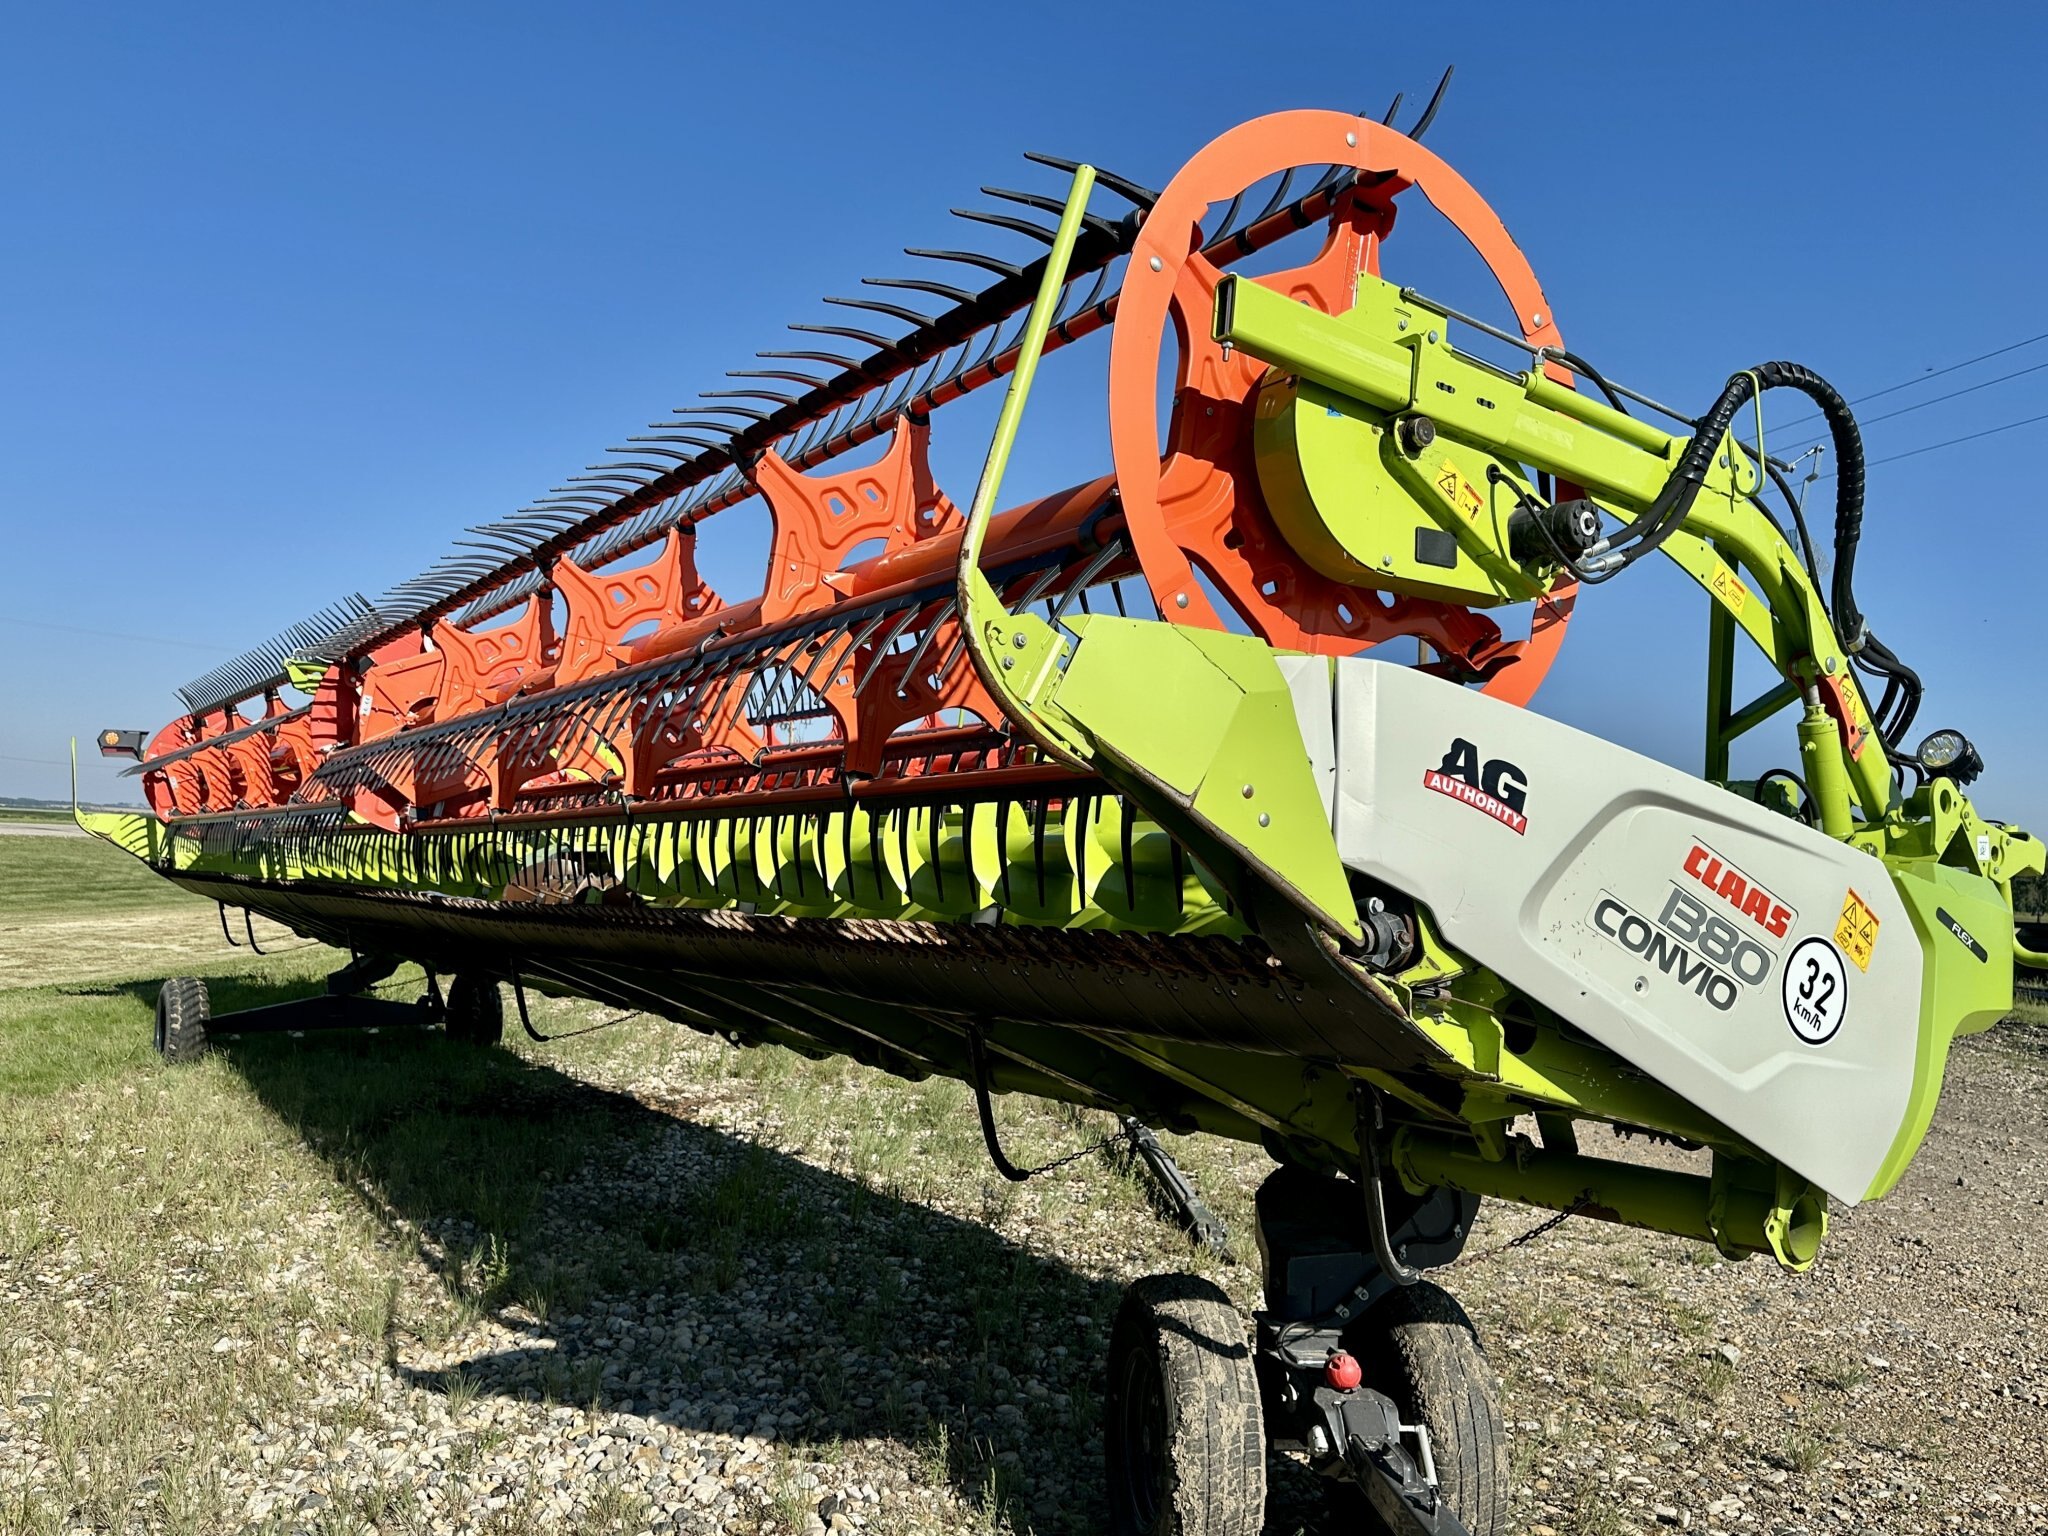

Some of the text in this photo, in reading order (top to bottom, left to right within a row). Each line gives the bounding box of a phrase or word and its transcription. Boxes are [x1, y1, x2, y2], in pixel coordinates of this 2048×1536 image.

[1430, 774, 1523, 827] AUTHORITY
[1438, 738, 1528, 814] AG
[1683, 845, 1792, 939] CLAAS
[1594, 898, 1738, 1012] CONVIO
[1658, 887, 1770, 986] 1380
[1952, 922, 1974, 949] FLEX
[1793, 996, 1822, 1032] km/h
[1799, 957, 1836, 1017] 32
